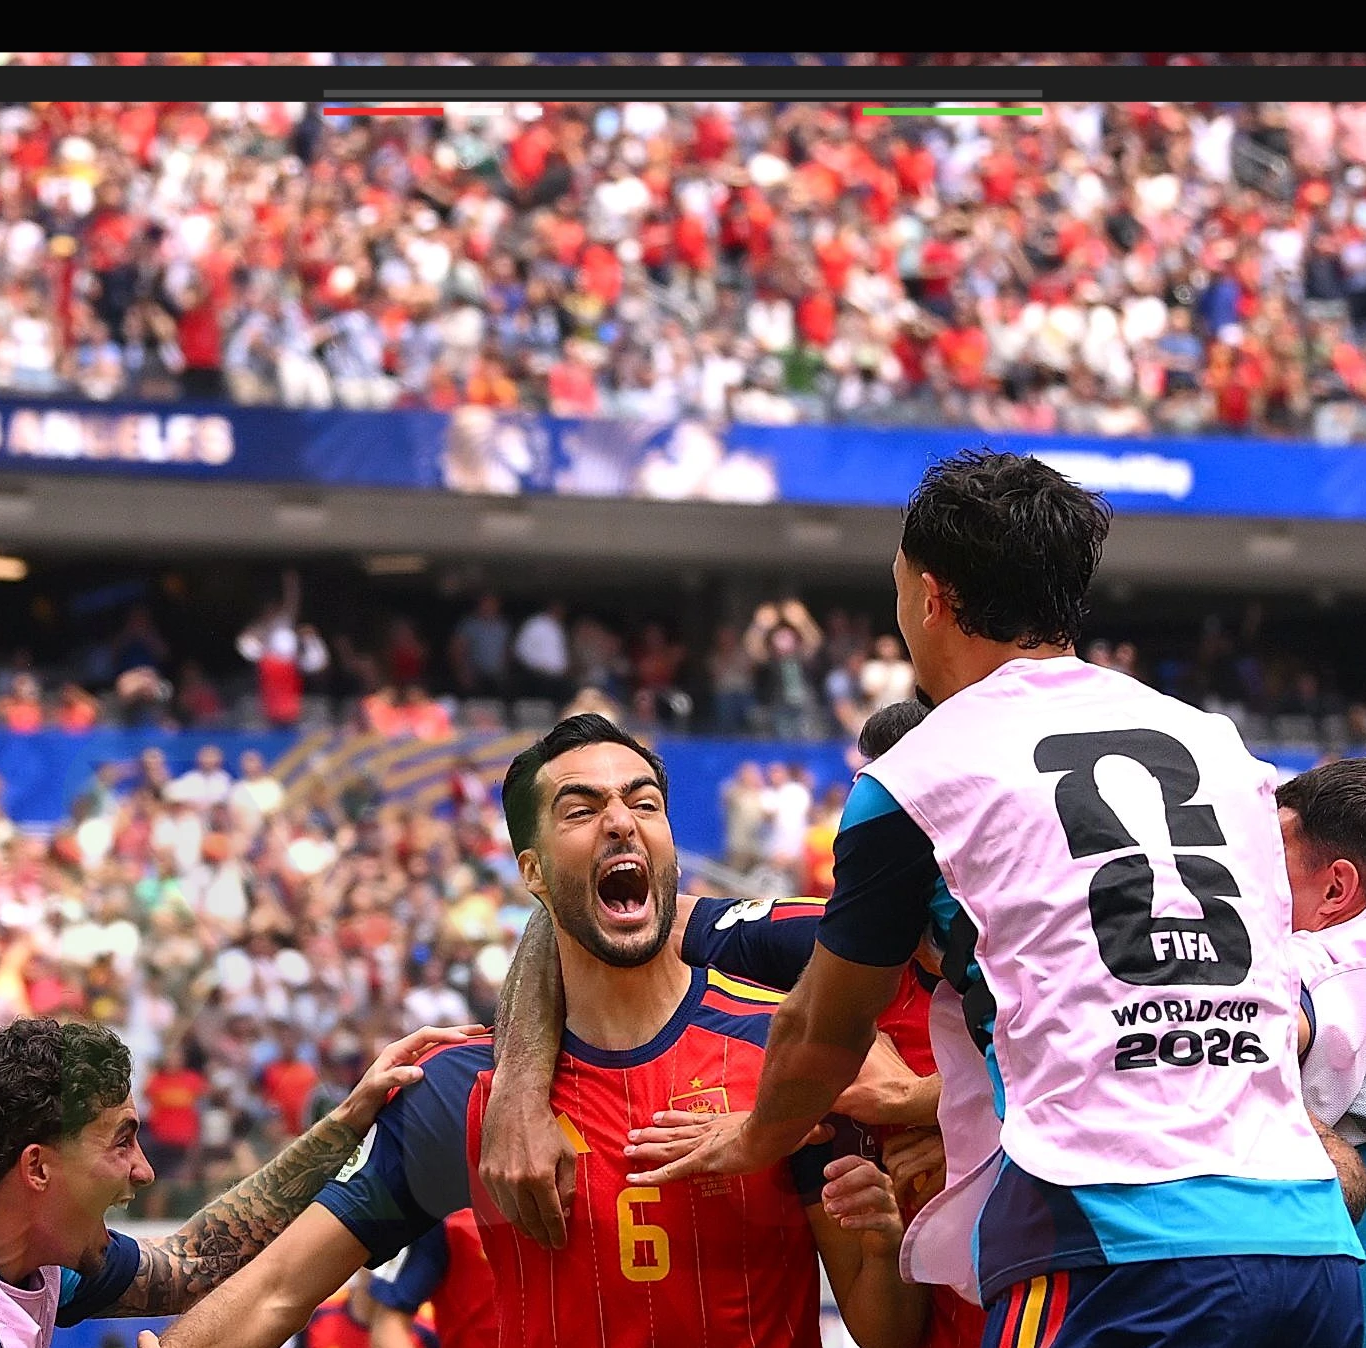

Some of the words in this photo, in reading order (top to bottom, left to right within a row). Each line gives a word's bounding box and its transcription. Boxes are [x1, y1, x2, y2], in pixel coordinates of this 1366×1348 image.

[1149, 930, 1220, 963] FIFA
[1111, 1000, 1213, 1028] WORLD
[1214, 999, 1259, 1025] CUP
[1115, 1028, 1270, 1072] 2026
[615, 1186, 672, 1283] 6
